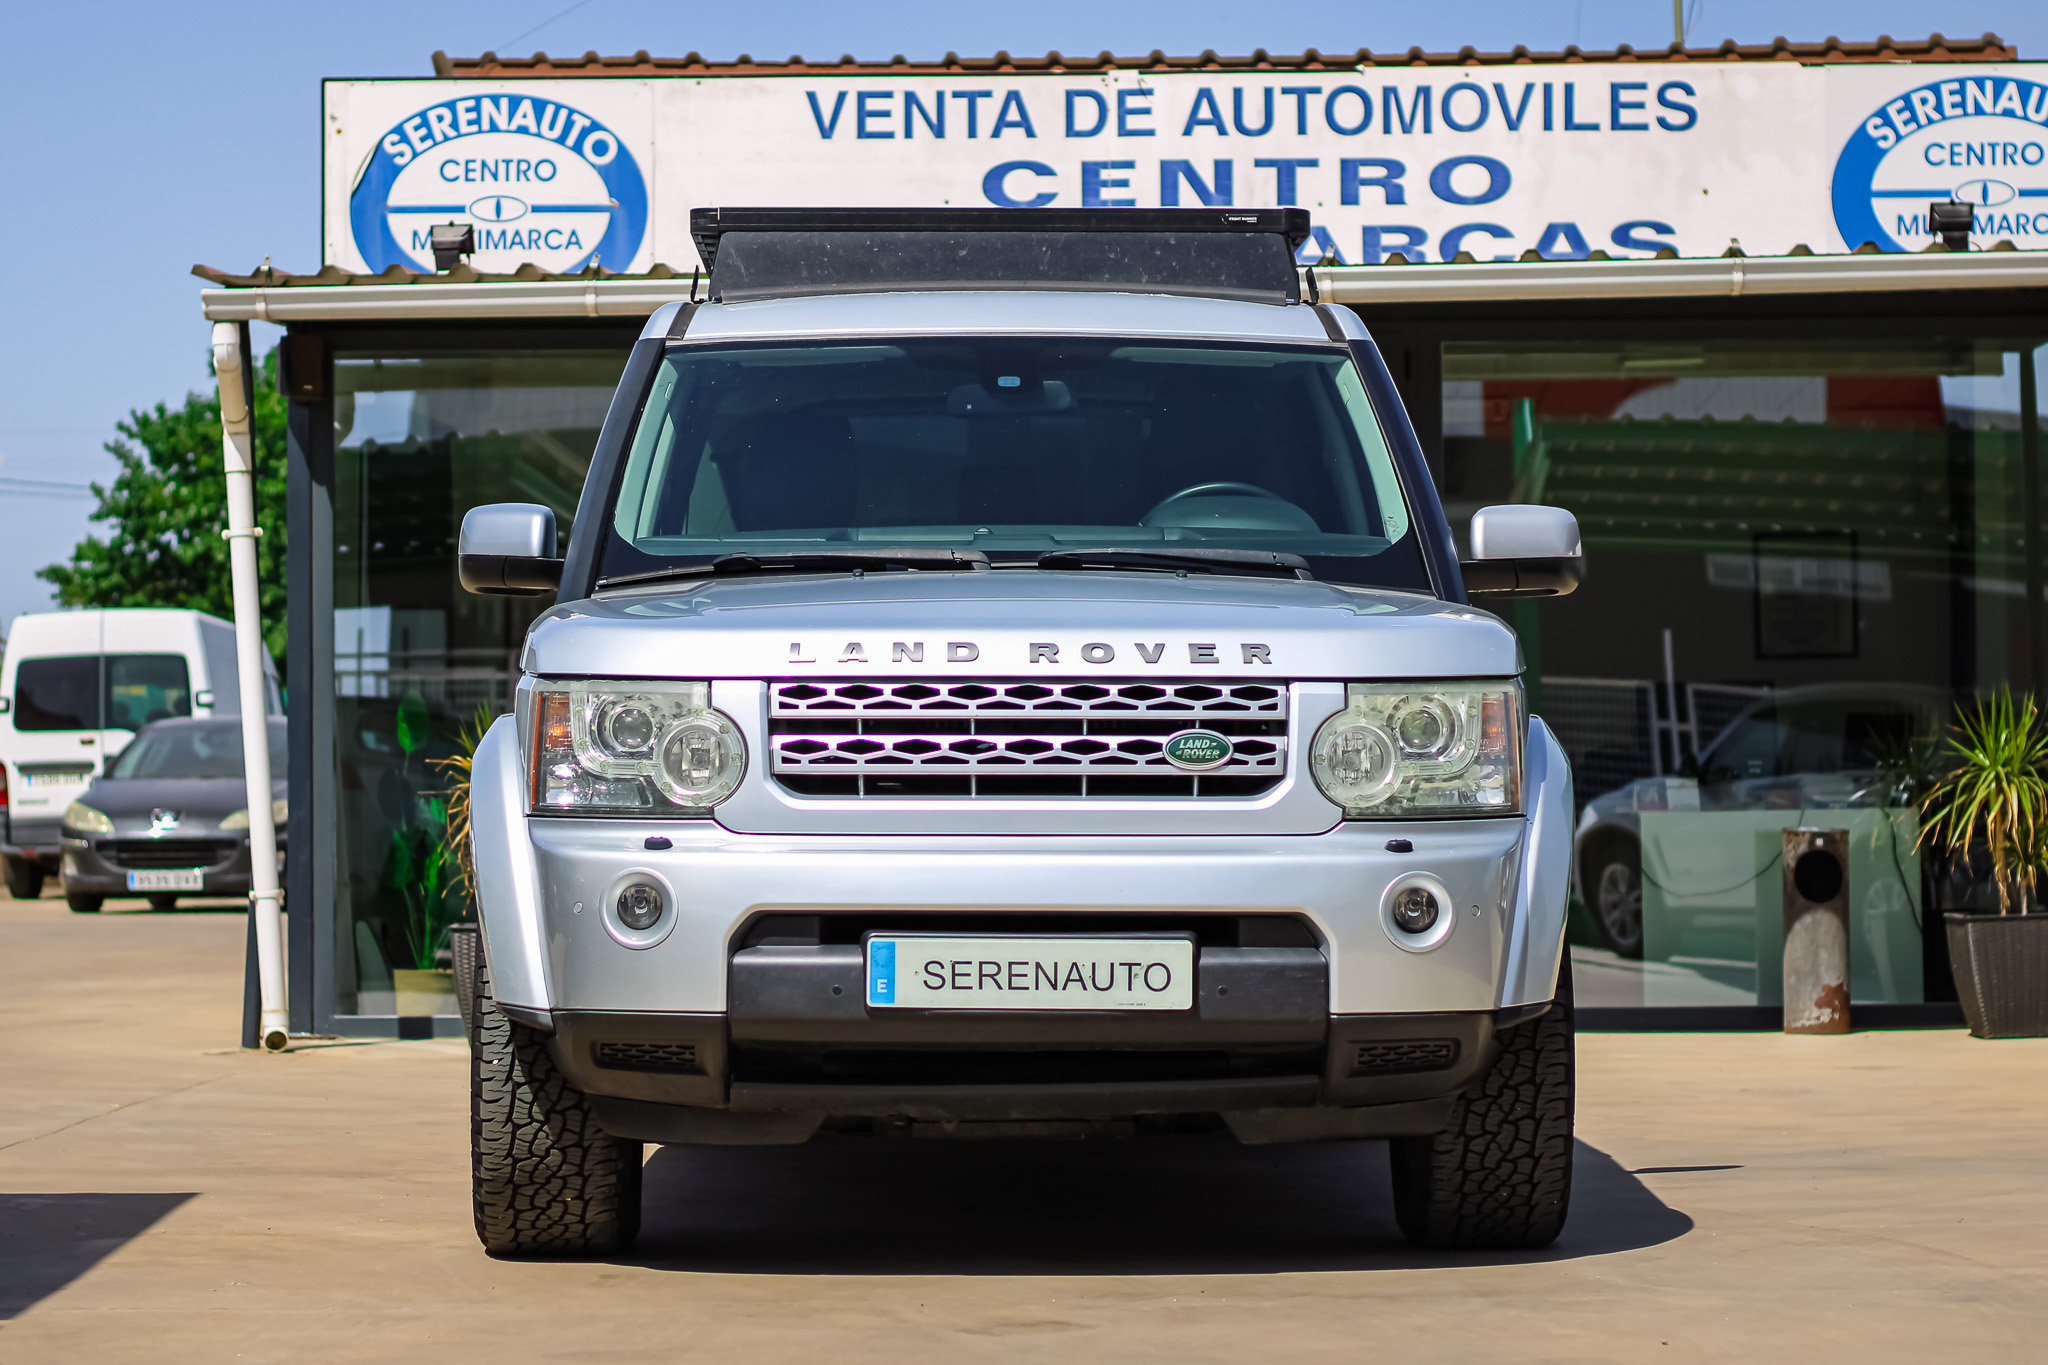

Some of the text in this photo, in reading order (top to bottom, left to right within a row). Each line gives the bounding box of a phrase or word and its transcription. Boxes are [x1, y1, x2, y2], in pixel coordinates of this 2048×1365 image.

[806, 81, 1698, 139] VENTA DE AUTOMOVILES
[382, 97, 619, 166] SERENAUTO
[1924, 141, 2046, 167] CENTRO
[439, 158, 557, 182] CENTRO
[981, 155, 1512, 208] CENTRO
[412, 228, 583, 250] MIMARCA
[789, 642, 1273, 665] LAND ROVER
[876, 978, 888, 993] E
[922, 960, 1172, 992] SERENAUTO
